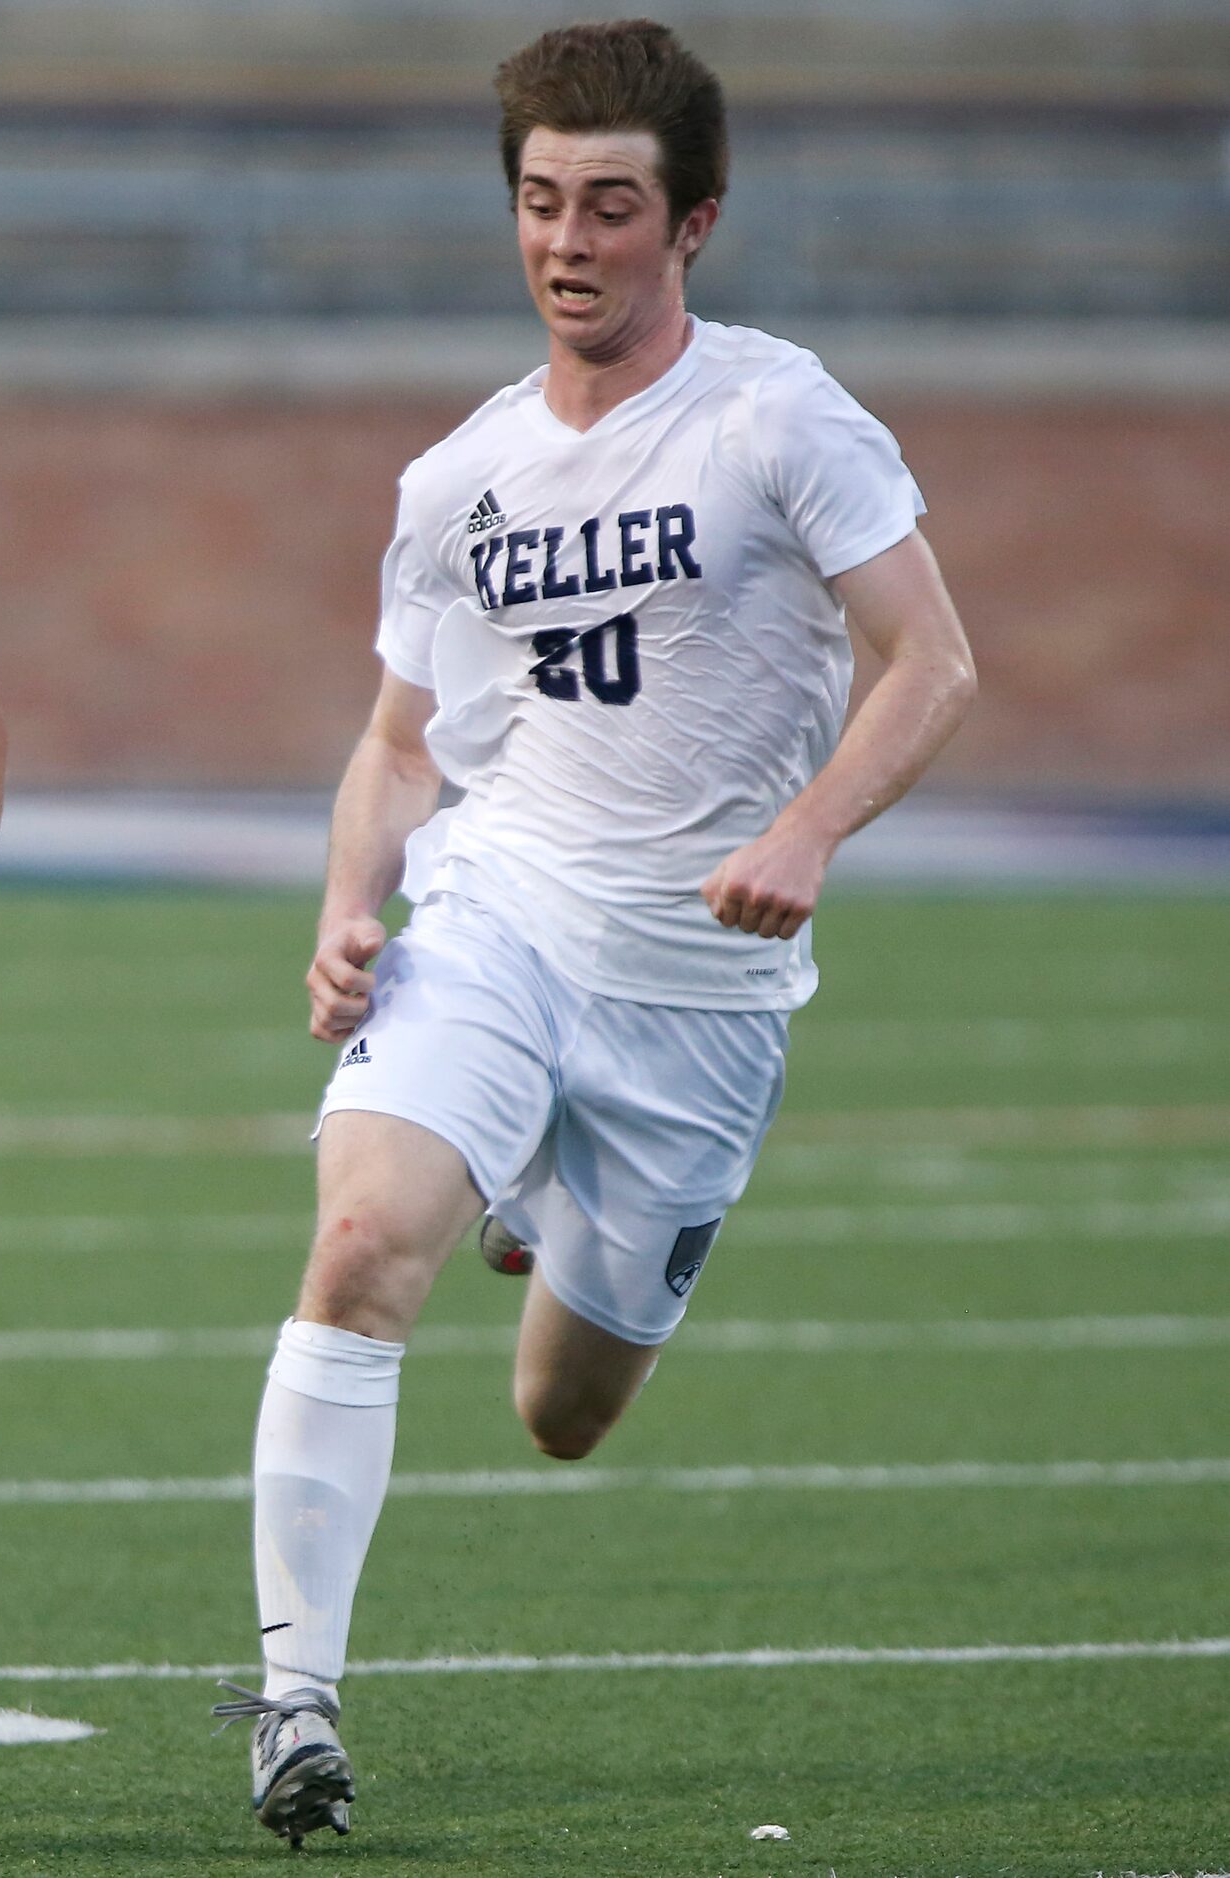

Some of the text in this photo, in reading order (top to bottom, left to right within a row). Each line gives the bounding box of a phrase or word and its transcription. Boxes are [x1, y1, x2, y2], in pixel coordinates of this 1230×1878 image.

[468, 513, 506, 534] adidas
[470, 503, 702, 609] KELLER
[528, 612, 642, 706] 20
[339, 1054, 372, 1070] didas
